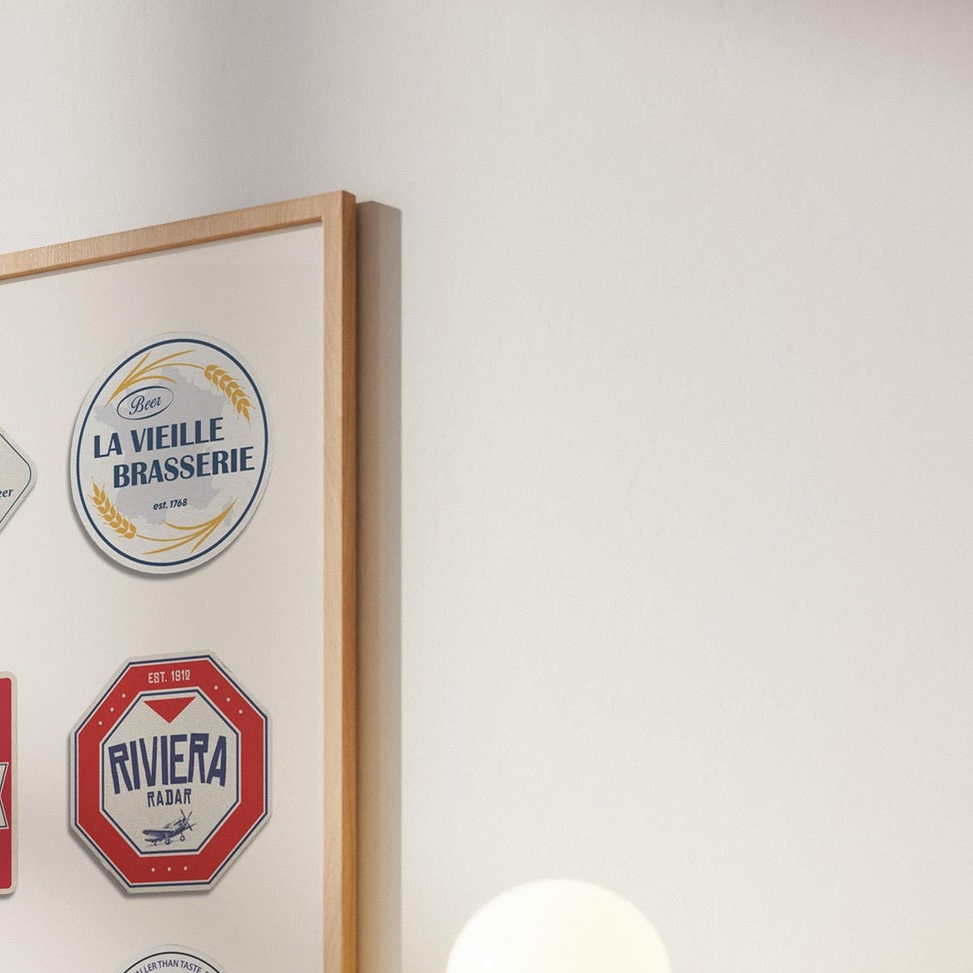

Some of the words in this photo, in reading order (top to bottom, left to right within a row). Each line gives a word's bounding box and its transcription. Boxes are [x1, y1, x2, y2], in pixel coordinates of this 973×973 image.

[129, 395, 162, 416] Beer
[94, 432, 122, 458] LA
[130, 417, 224, 452] VIEILLE
[113, 446, 255, 489] BRASSERIE
[153, 501, 168, 510] est.
[170, 498, 187, 508] 1768
[148, 672, 167, 683] EST.
[171, 670, 190, 681] 1912
[108, 733, 227, 794] RIVIERA
[147, 788, 192, 808] RADAR
[158, 960, 178, 969] THAN
